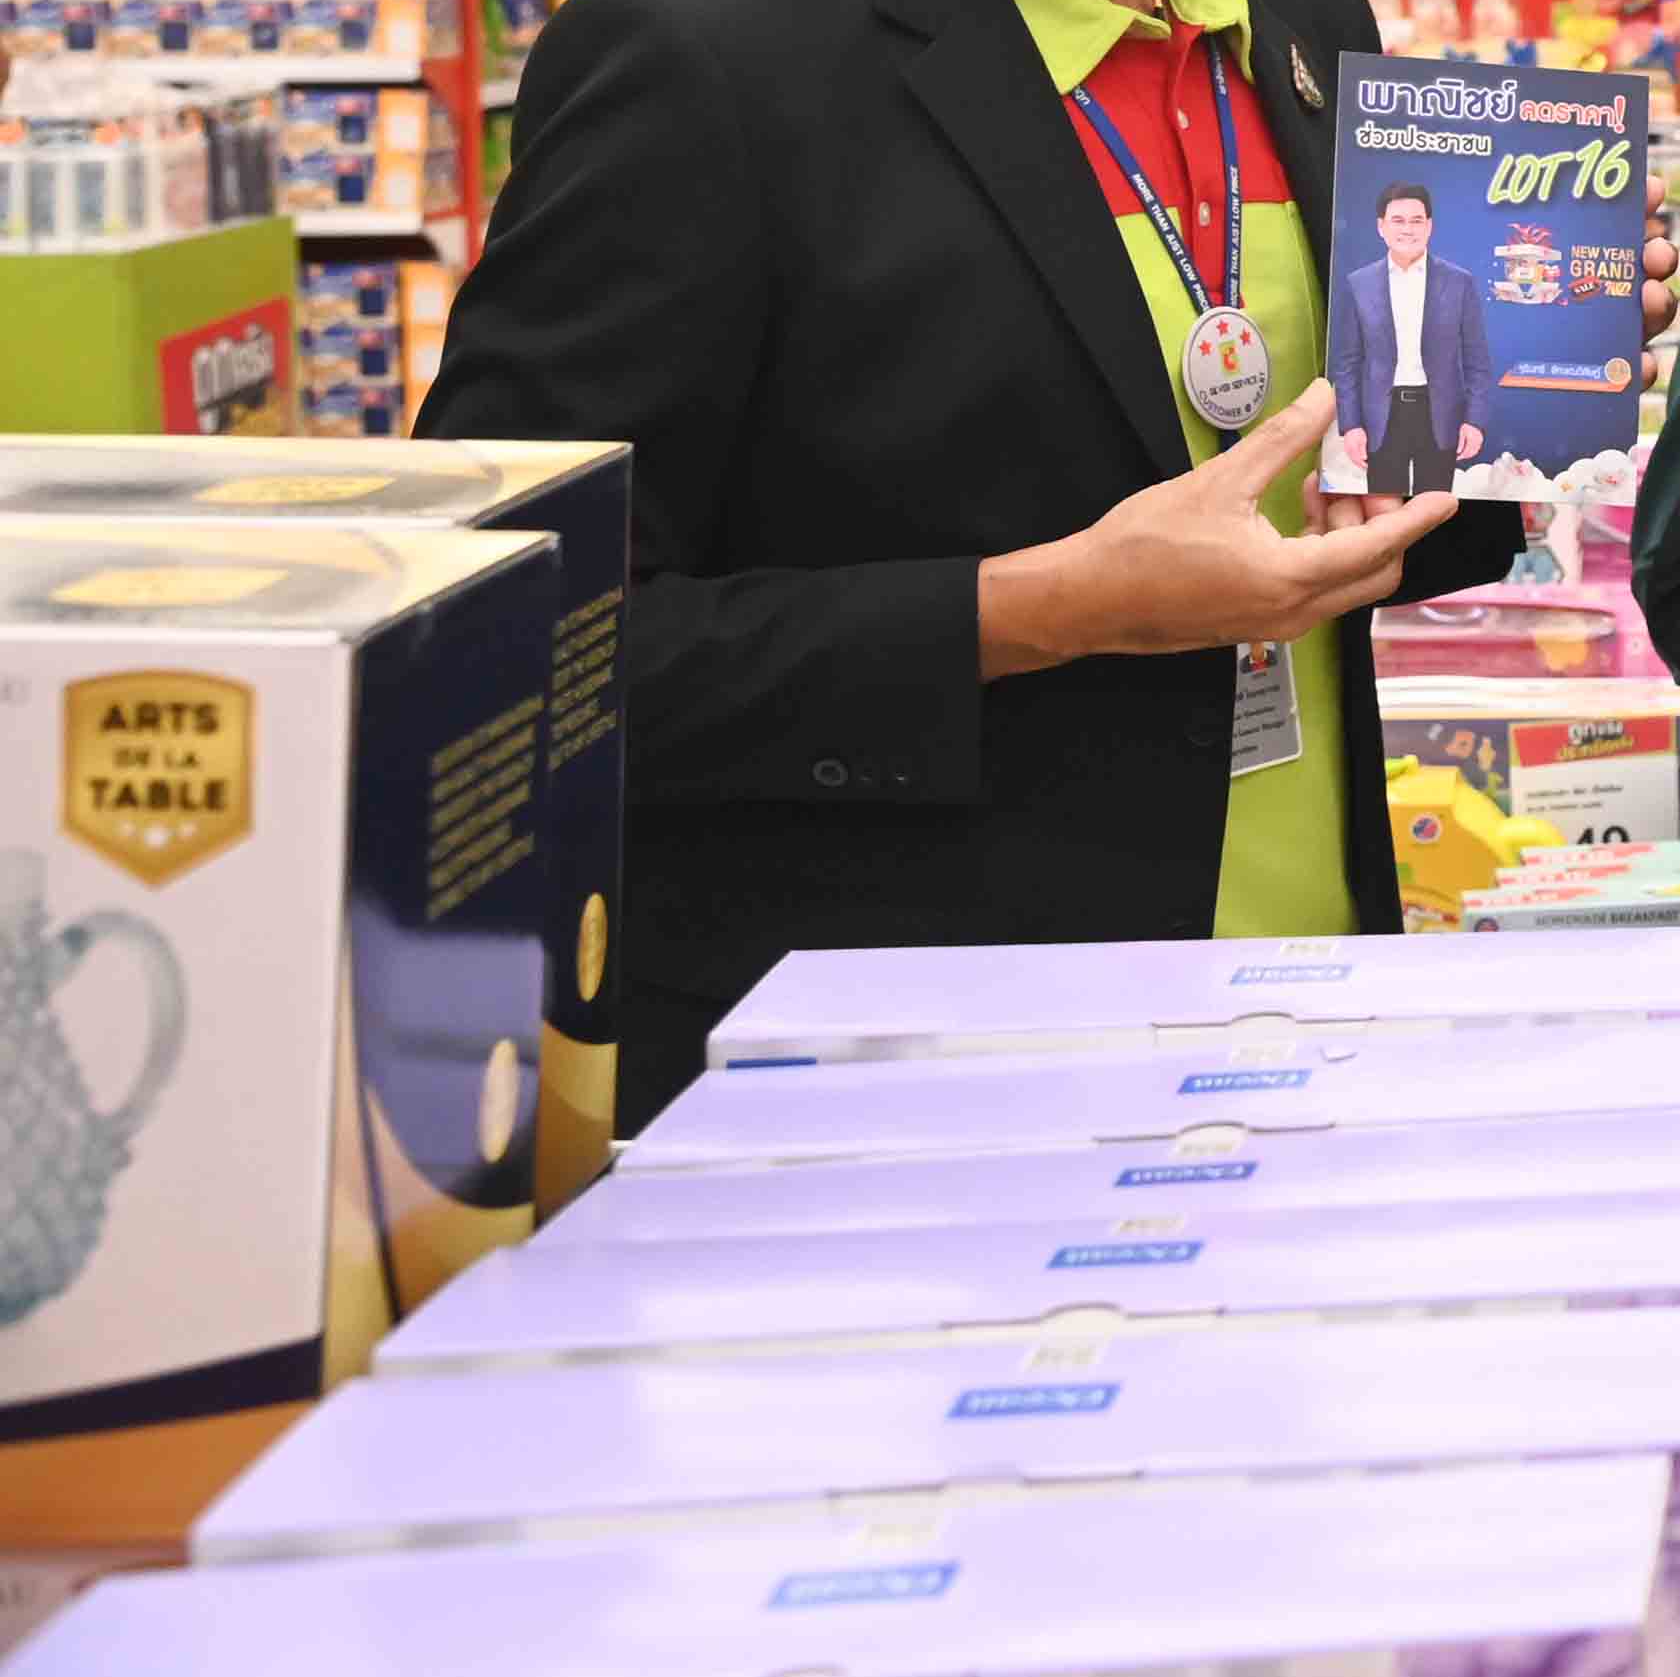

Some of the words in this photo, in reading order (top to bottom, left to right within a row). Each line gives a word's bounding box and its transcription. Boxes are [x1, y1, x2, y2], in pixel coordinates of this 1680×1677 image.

[1358, 78, 1518, 122] พาณิชย์
[1519, 94, 1627, 134] ลดราคา!
[1356, 120, 1493, 155] ช่วยประชาชน
[1487, 152, 1574, 204] LOT
[1573, 139, 1631, 200] 16
[1151, 204, 1170, 231] THAN
[1179, 257, 1197, 282] LOW
[1570, 245, 1600, 260] NEW
[1602, 246, 1636, 262] YEAR
[1569, 260, 1636, 280] GRAND
[102, 701, 220, 735] ARTS
[114, 747, 150, 768] DE
[88, 778, 228, 812] TABLE
